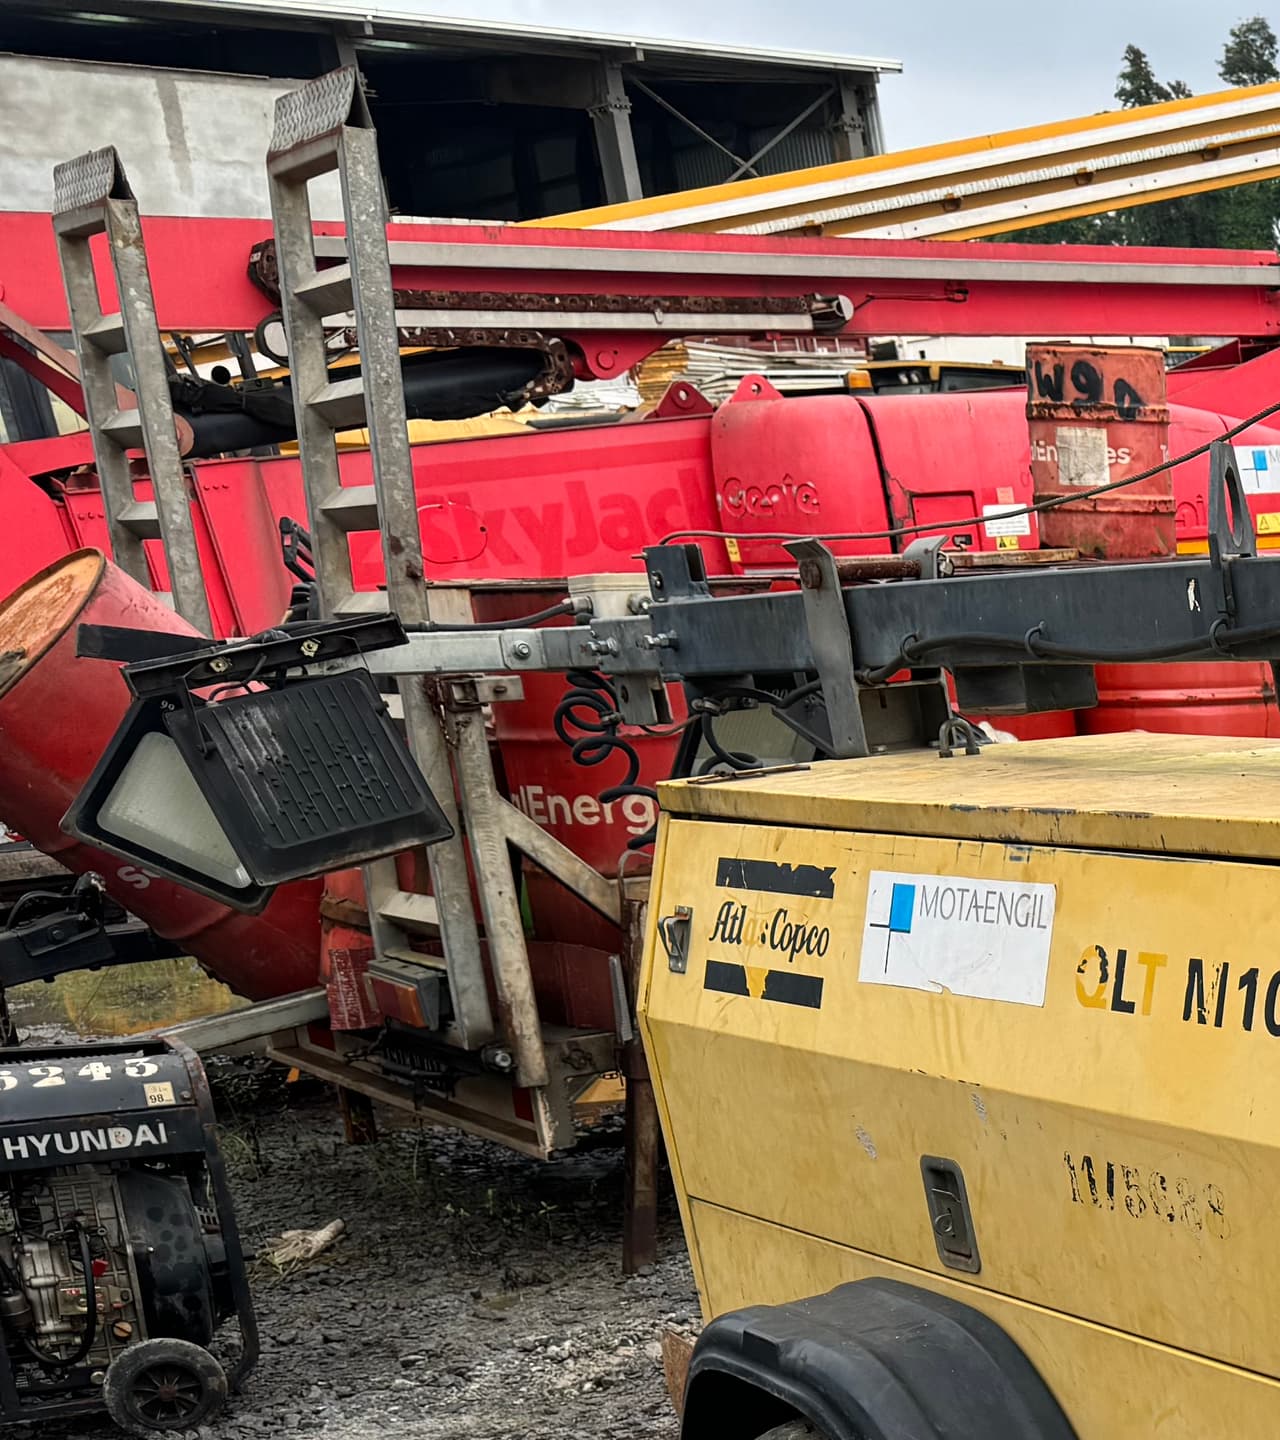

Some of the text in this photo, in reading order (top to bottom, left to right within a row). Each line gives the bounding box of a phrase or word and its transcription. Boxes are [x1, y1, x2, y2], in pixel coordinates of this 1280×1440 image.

[769, 907, 830, 963] Copco
[1074, 944, 1168, 1017] QLT
[3, 1122, 168, 1161] HYUNDAI
